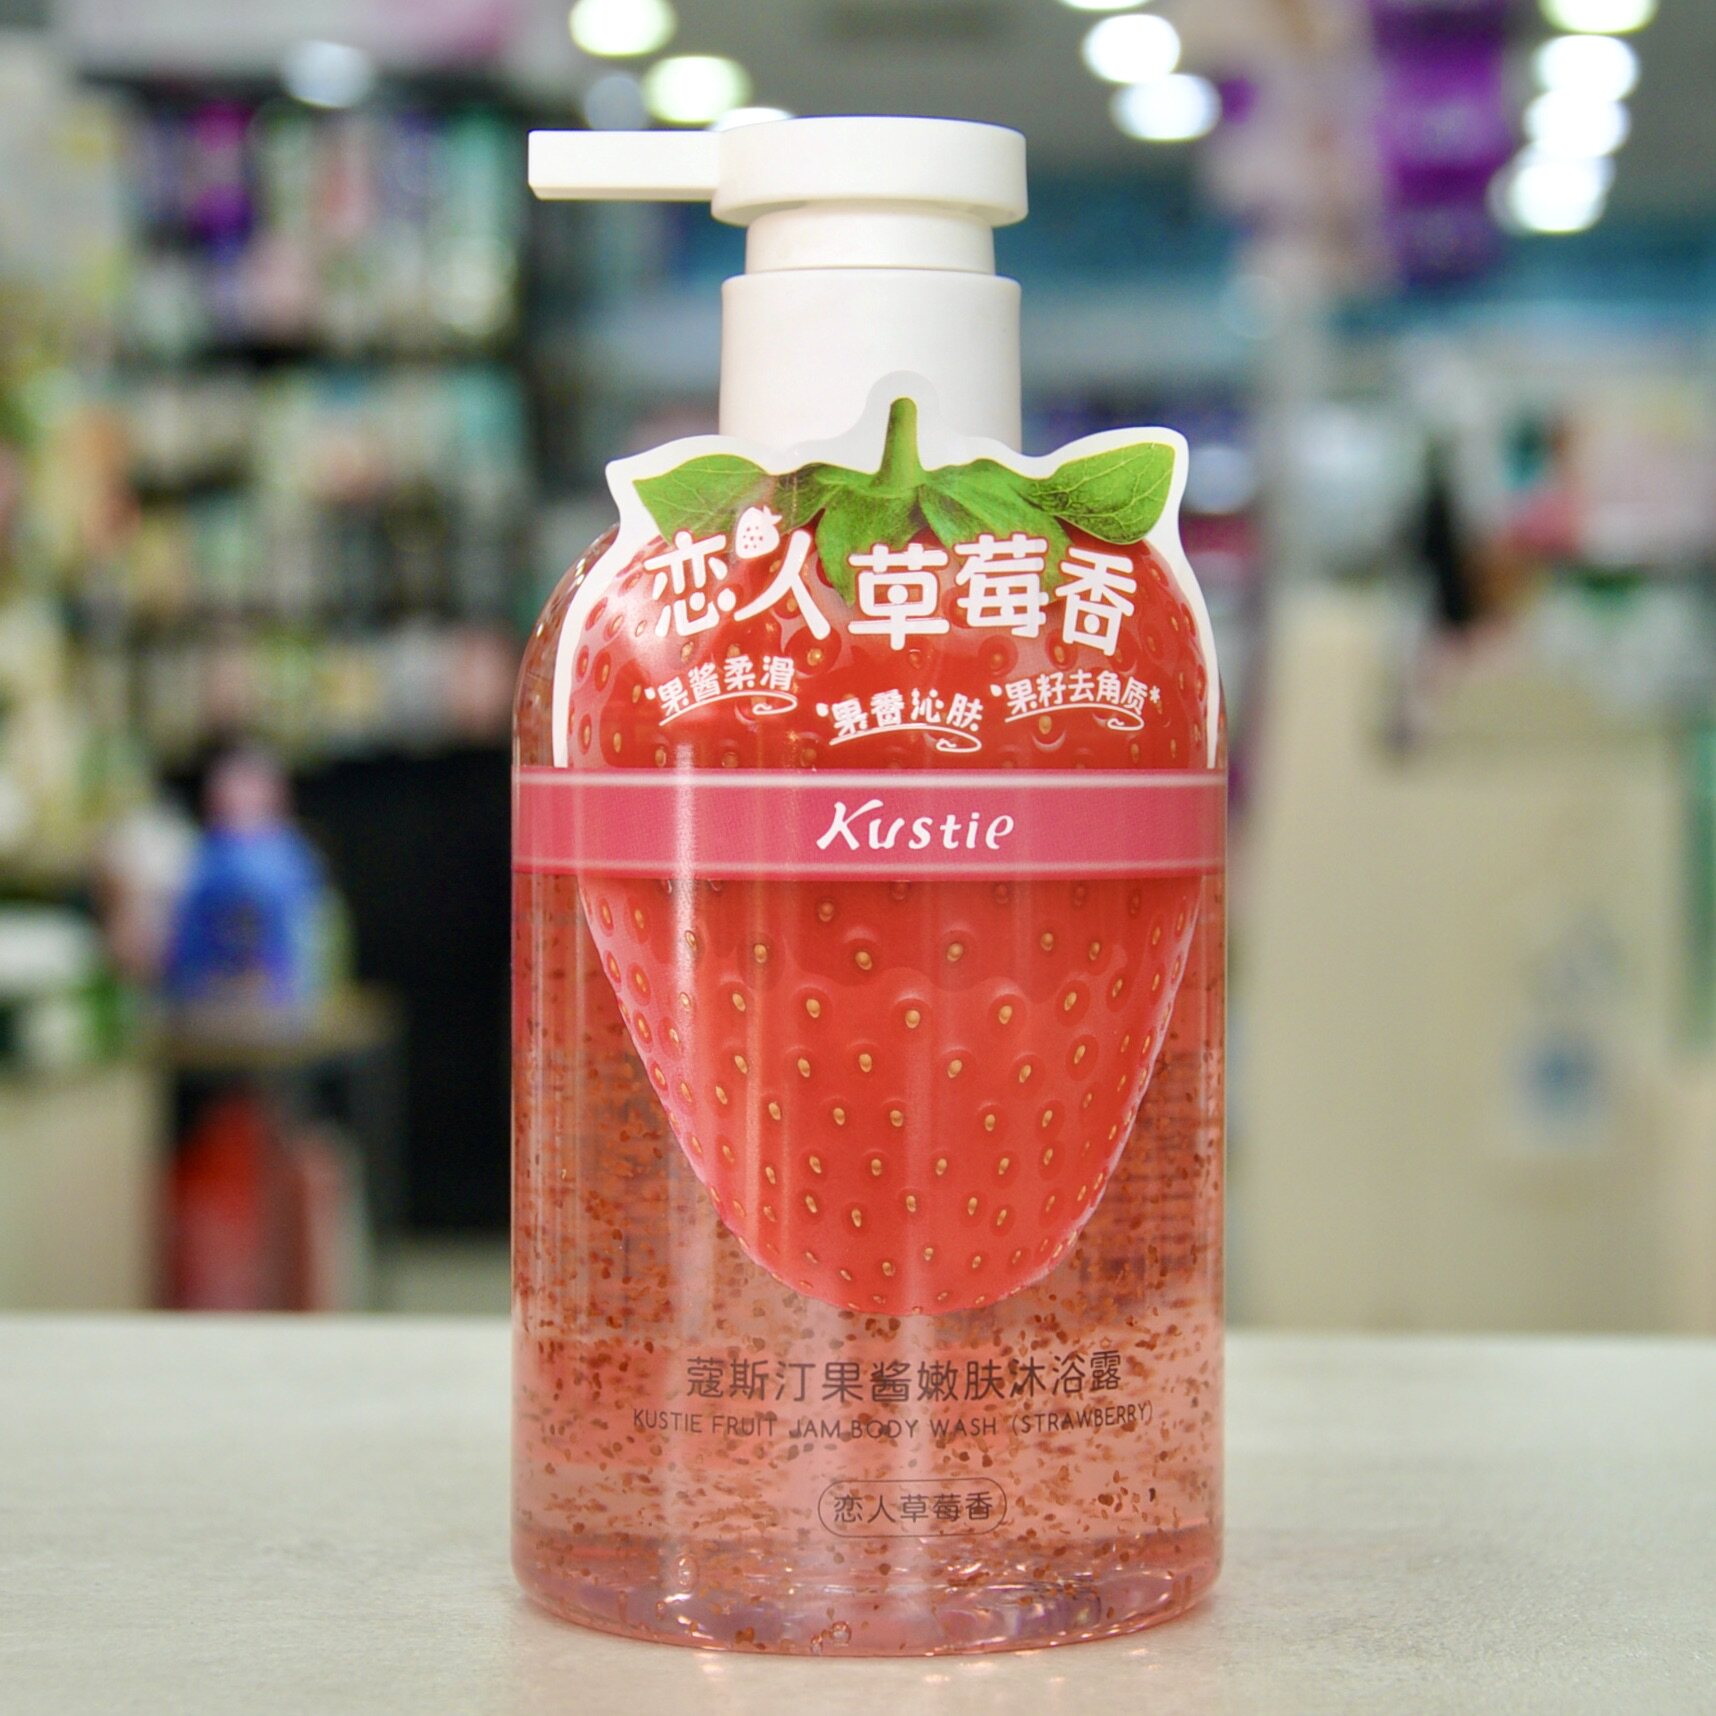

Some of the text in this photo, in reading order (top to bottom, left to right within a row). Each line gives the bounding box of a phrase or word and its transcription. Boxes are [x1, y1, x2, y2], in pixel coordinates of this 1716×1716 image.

[643, 529, 1138, 657] 恋人草莓香
[657, 654, 796, 717] 果酱柔滑
[815, 798, 1015, 851] Kustie
[686, 1350, 1122, 1403] 蔻斯汀果酱嫩肤沐浴露
[633, 1399, 1154, 1440] KUSTIE FRUIT JAM BODY WASH (STRAWBERRY)
[833, 1490, 993, 1524] 恋人草莓香
